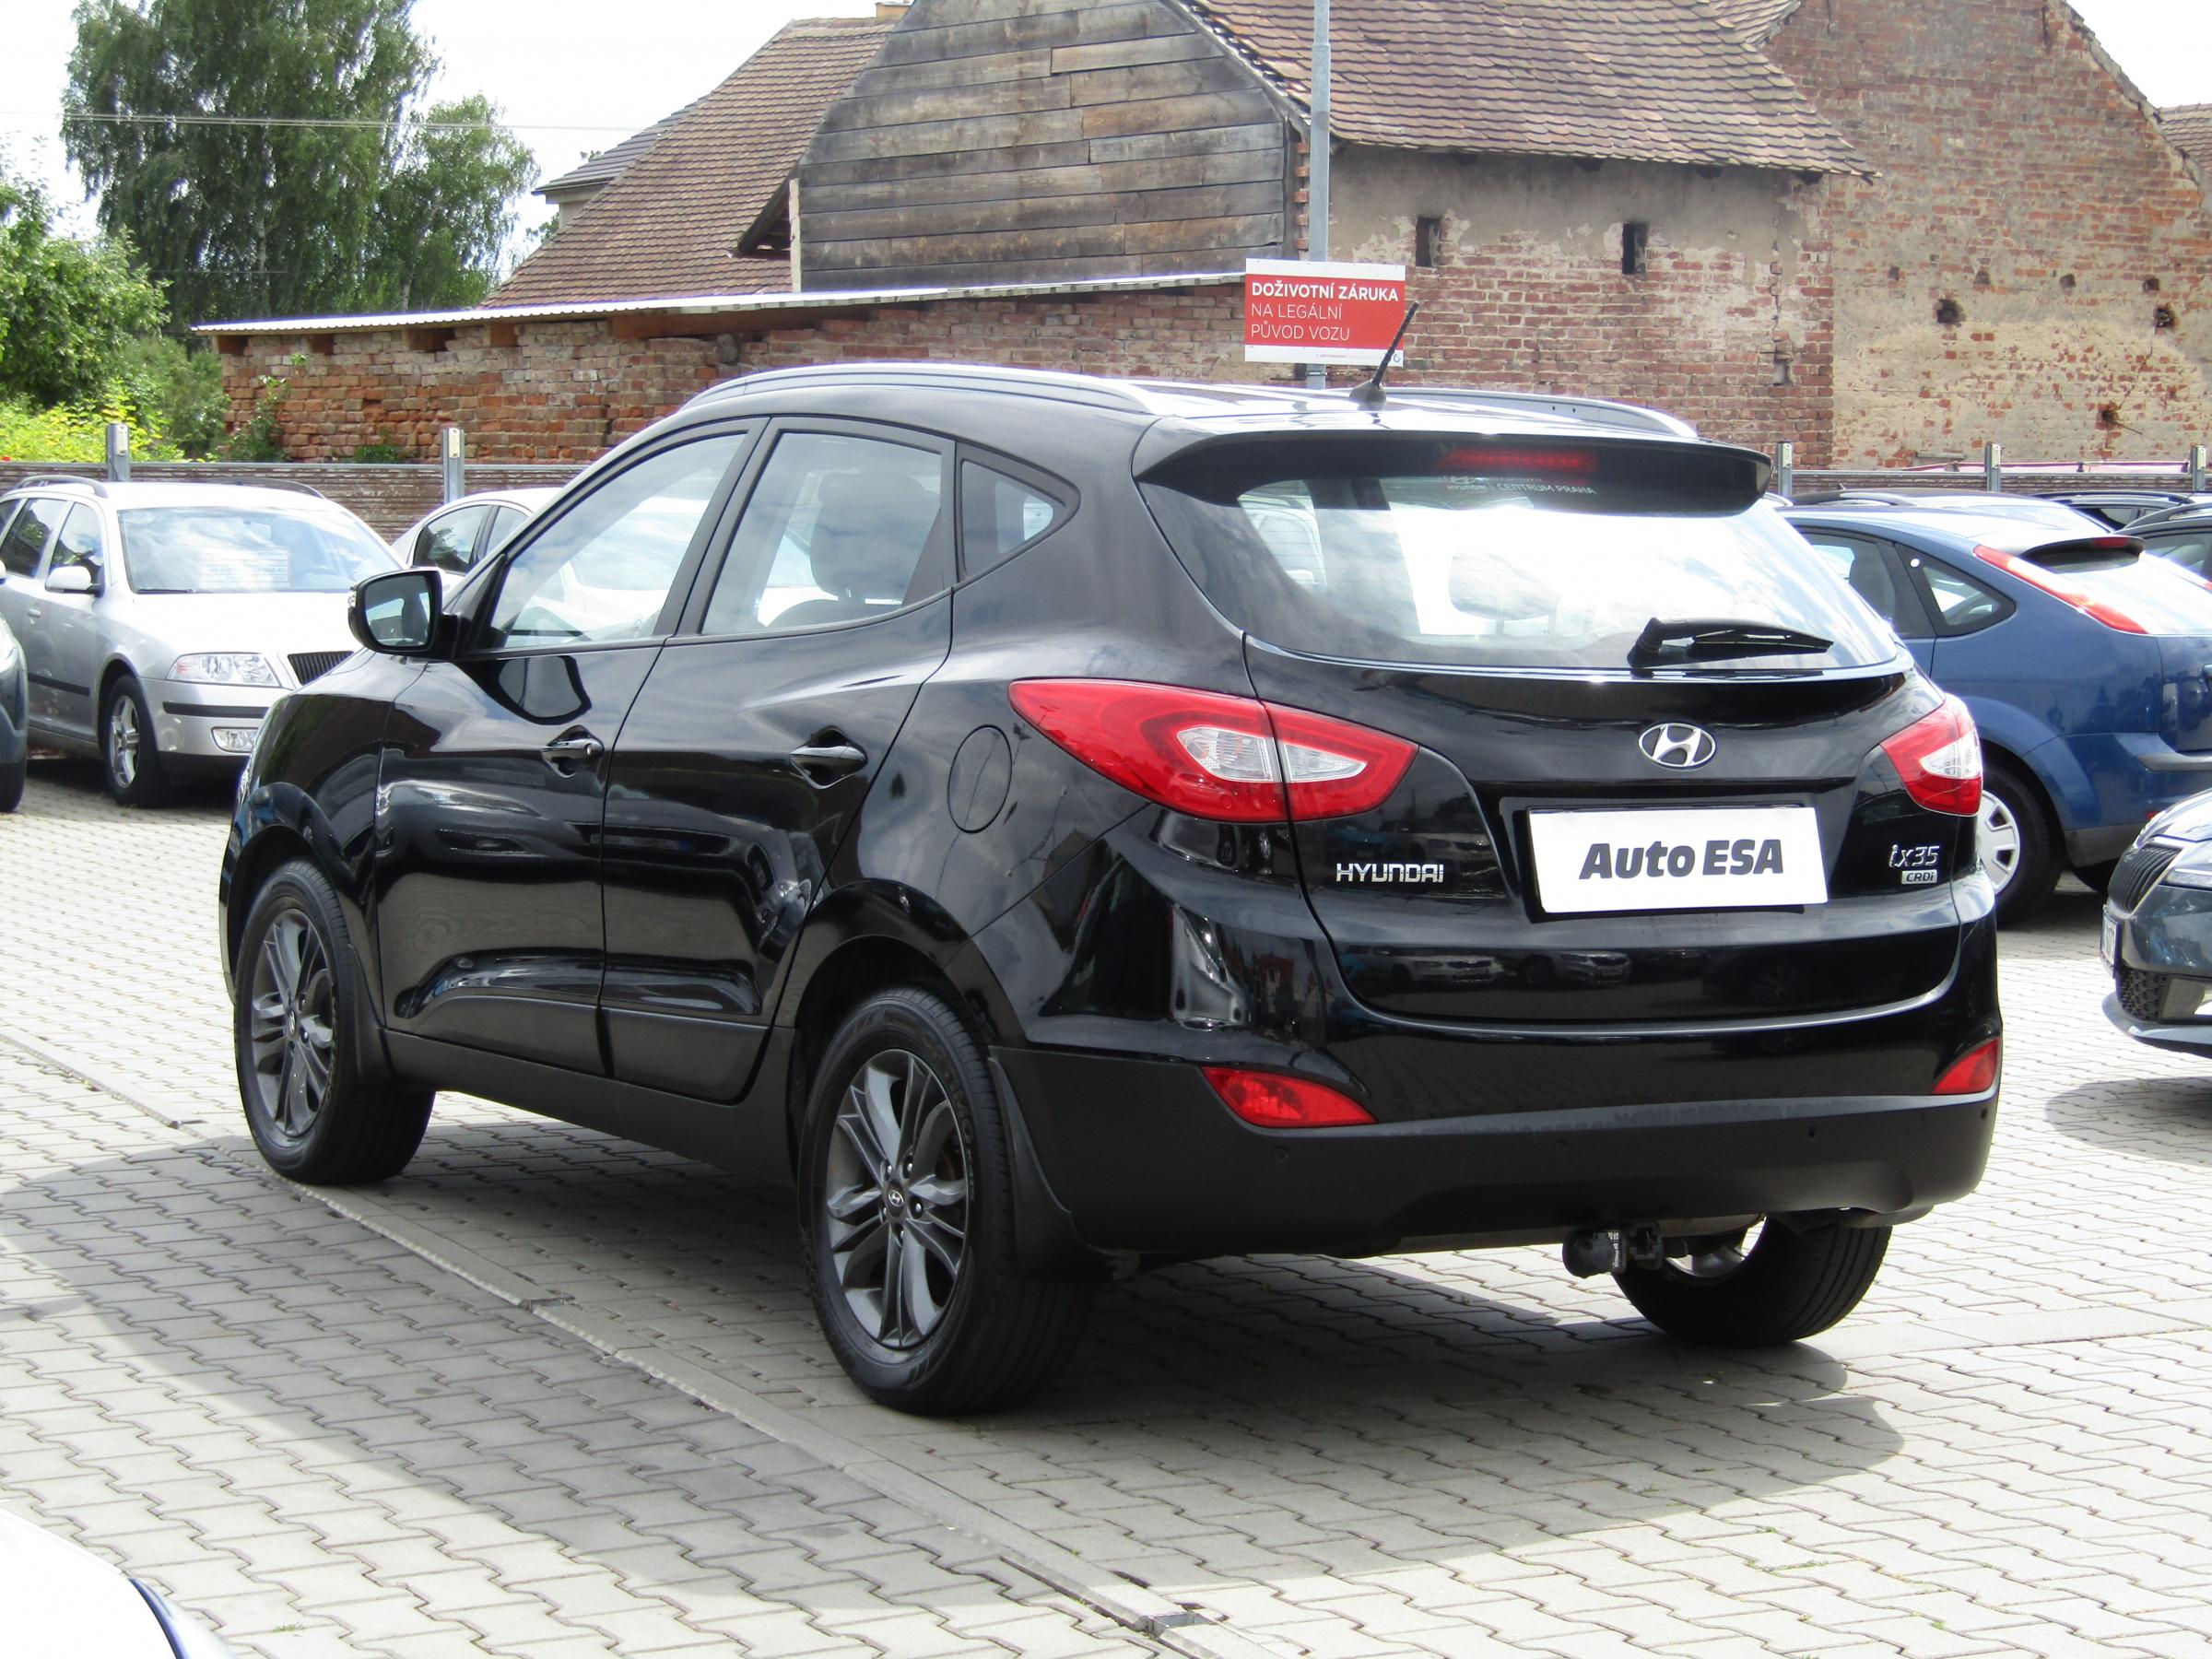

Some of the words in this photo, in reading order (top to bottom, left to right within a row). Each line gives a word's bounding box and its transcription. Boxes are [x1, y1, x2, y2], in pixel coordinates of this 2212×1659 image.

[1252, 279, 1335, 300] DOŽIVOTNÍ
[1338, 283, 1399, 302] ZÁRUKA
[1251, 303, 1274, 318] NA
[1277, 302, 1343, 320] LEGÁLNÍ
[1251, 320, 1304, 339] PŮVOD
[1309, 325, 1350, 341] VOZU
[1496, 483, 1554, 492] CENTRUM
[1555, 485, 1597, 495] PRAHA
[1578, 841, 1696, 880] Auto
[1702, 839, 1784, 876] ESA
[1888, 843, 1940, 868] ix35
[1335, 863, 1444, 883] HYUNDAI
[1906, 871, 1935, 883] CRDi
